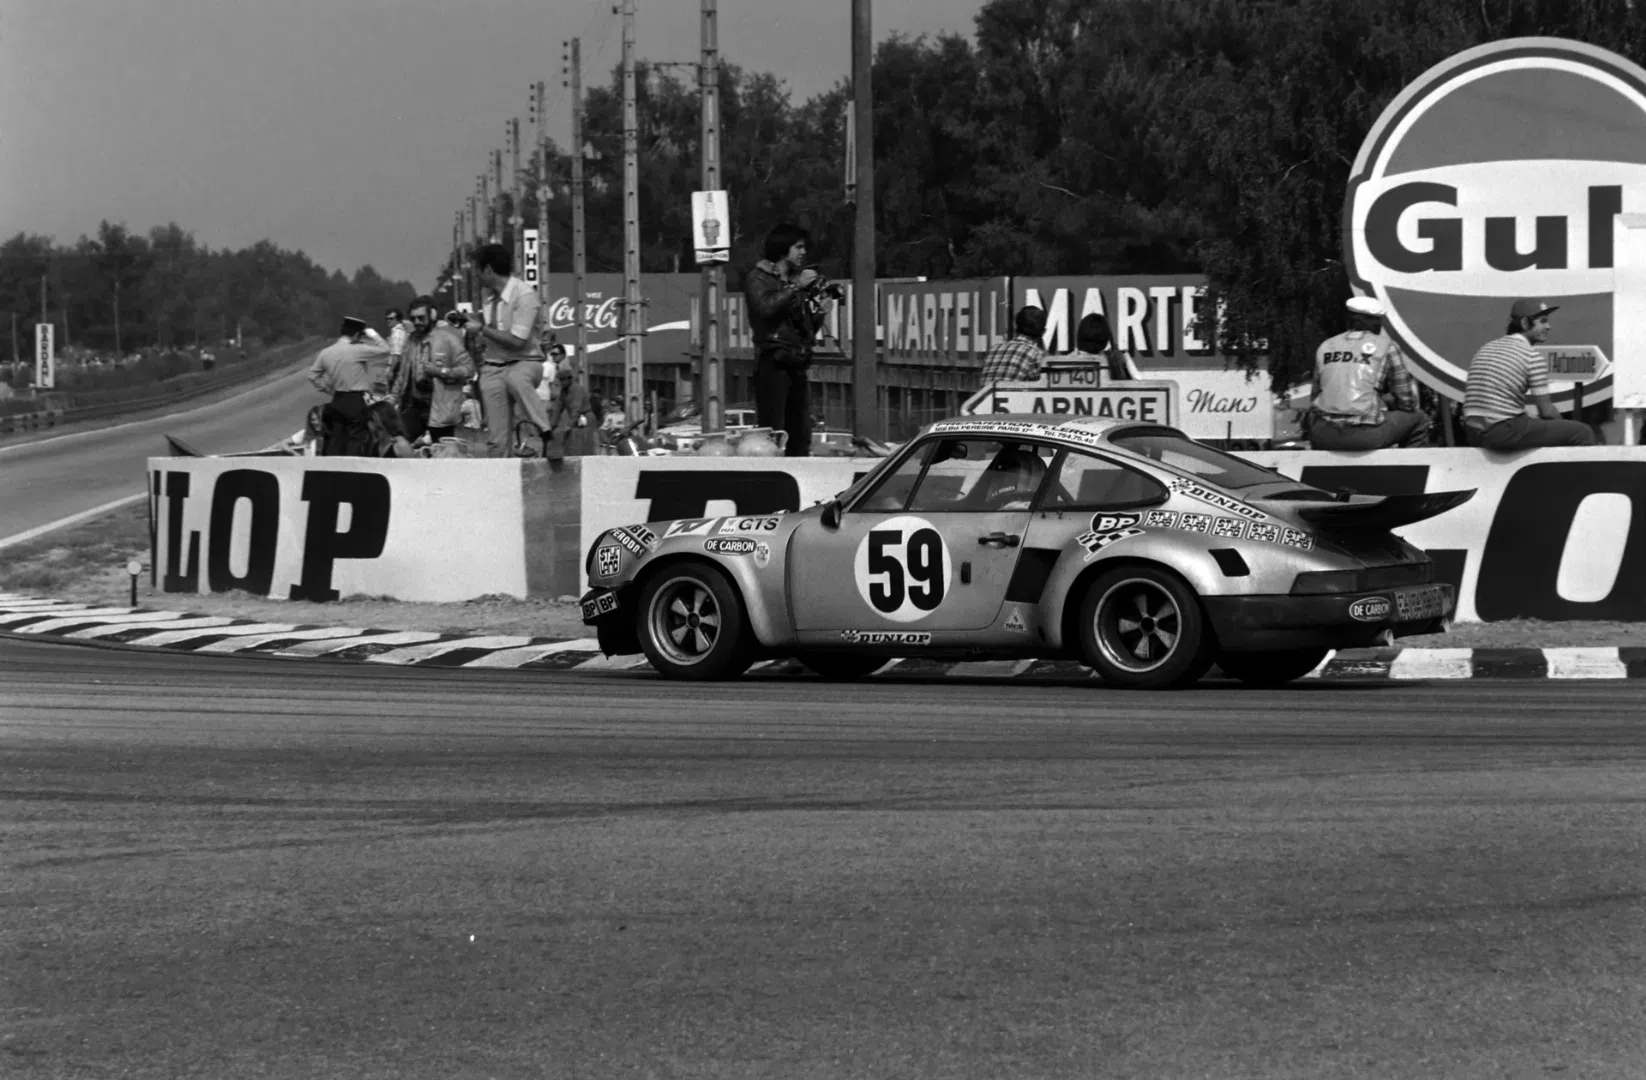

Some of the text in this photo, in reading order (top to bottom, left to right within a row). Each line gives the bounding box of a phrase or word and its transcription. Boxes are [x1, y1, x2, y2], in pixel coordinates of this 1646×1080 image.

[1364, 181, 1622, 273] Gul
[887, 291, 1003, 351] MARTELL
[41, 325, 49, 387] BARDAHL
[1068, 368, 1096, 385] 140
[1032, 397, 1158, 423] ARNAGE
[1051, 425, 1099, 438] LEROY
[1190, 486, 1267, 521] DUNLOP
[738, 517, 780, 531] GTS
[1097, 516, 1136, 531] BP
[707, 541, 755, 552] DE CARBON
[868, 527, 945, 614] 59
[584, 602, 596, 618] BP
[600, 596, 614, 612] BP
[1354, 603, 1390, 616] DE CARBON
[858, 633, 930, 643] DUNLOP
